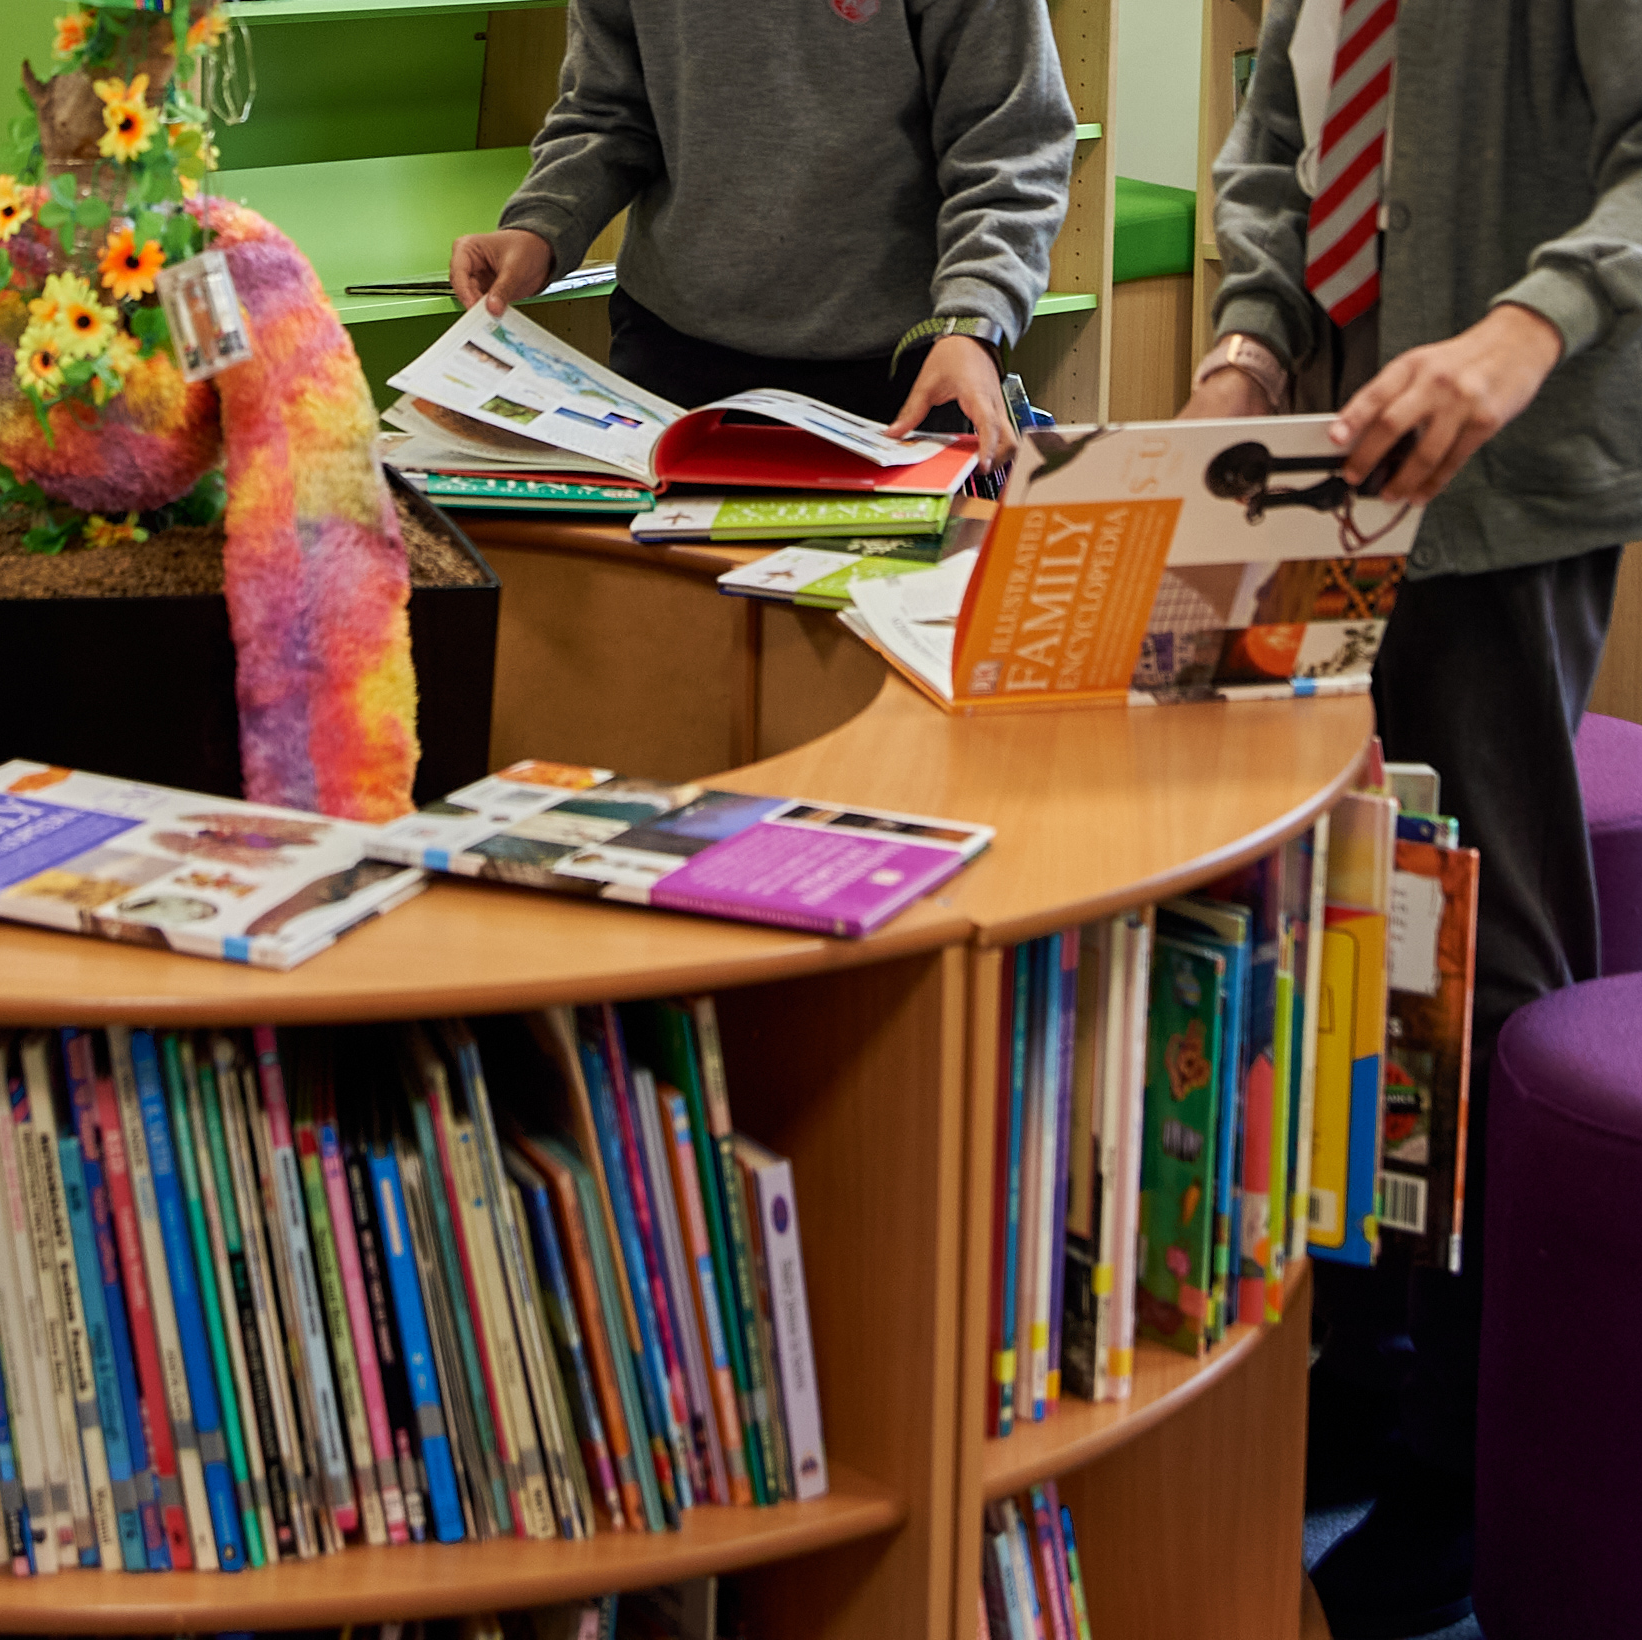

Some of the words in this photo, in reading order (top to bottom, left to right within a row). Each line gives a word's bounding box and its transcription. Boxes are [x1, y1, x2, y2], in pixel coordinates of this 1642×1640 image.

[989, 509, 1046, 653] ILLUSTRATED
[1005, 513, 1094, 693] FAMILY
[1057, 507, 1129, 692] ENCYCLOPEDIA
